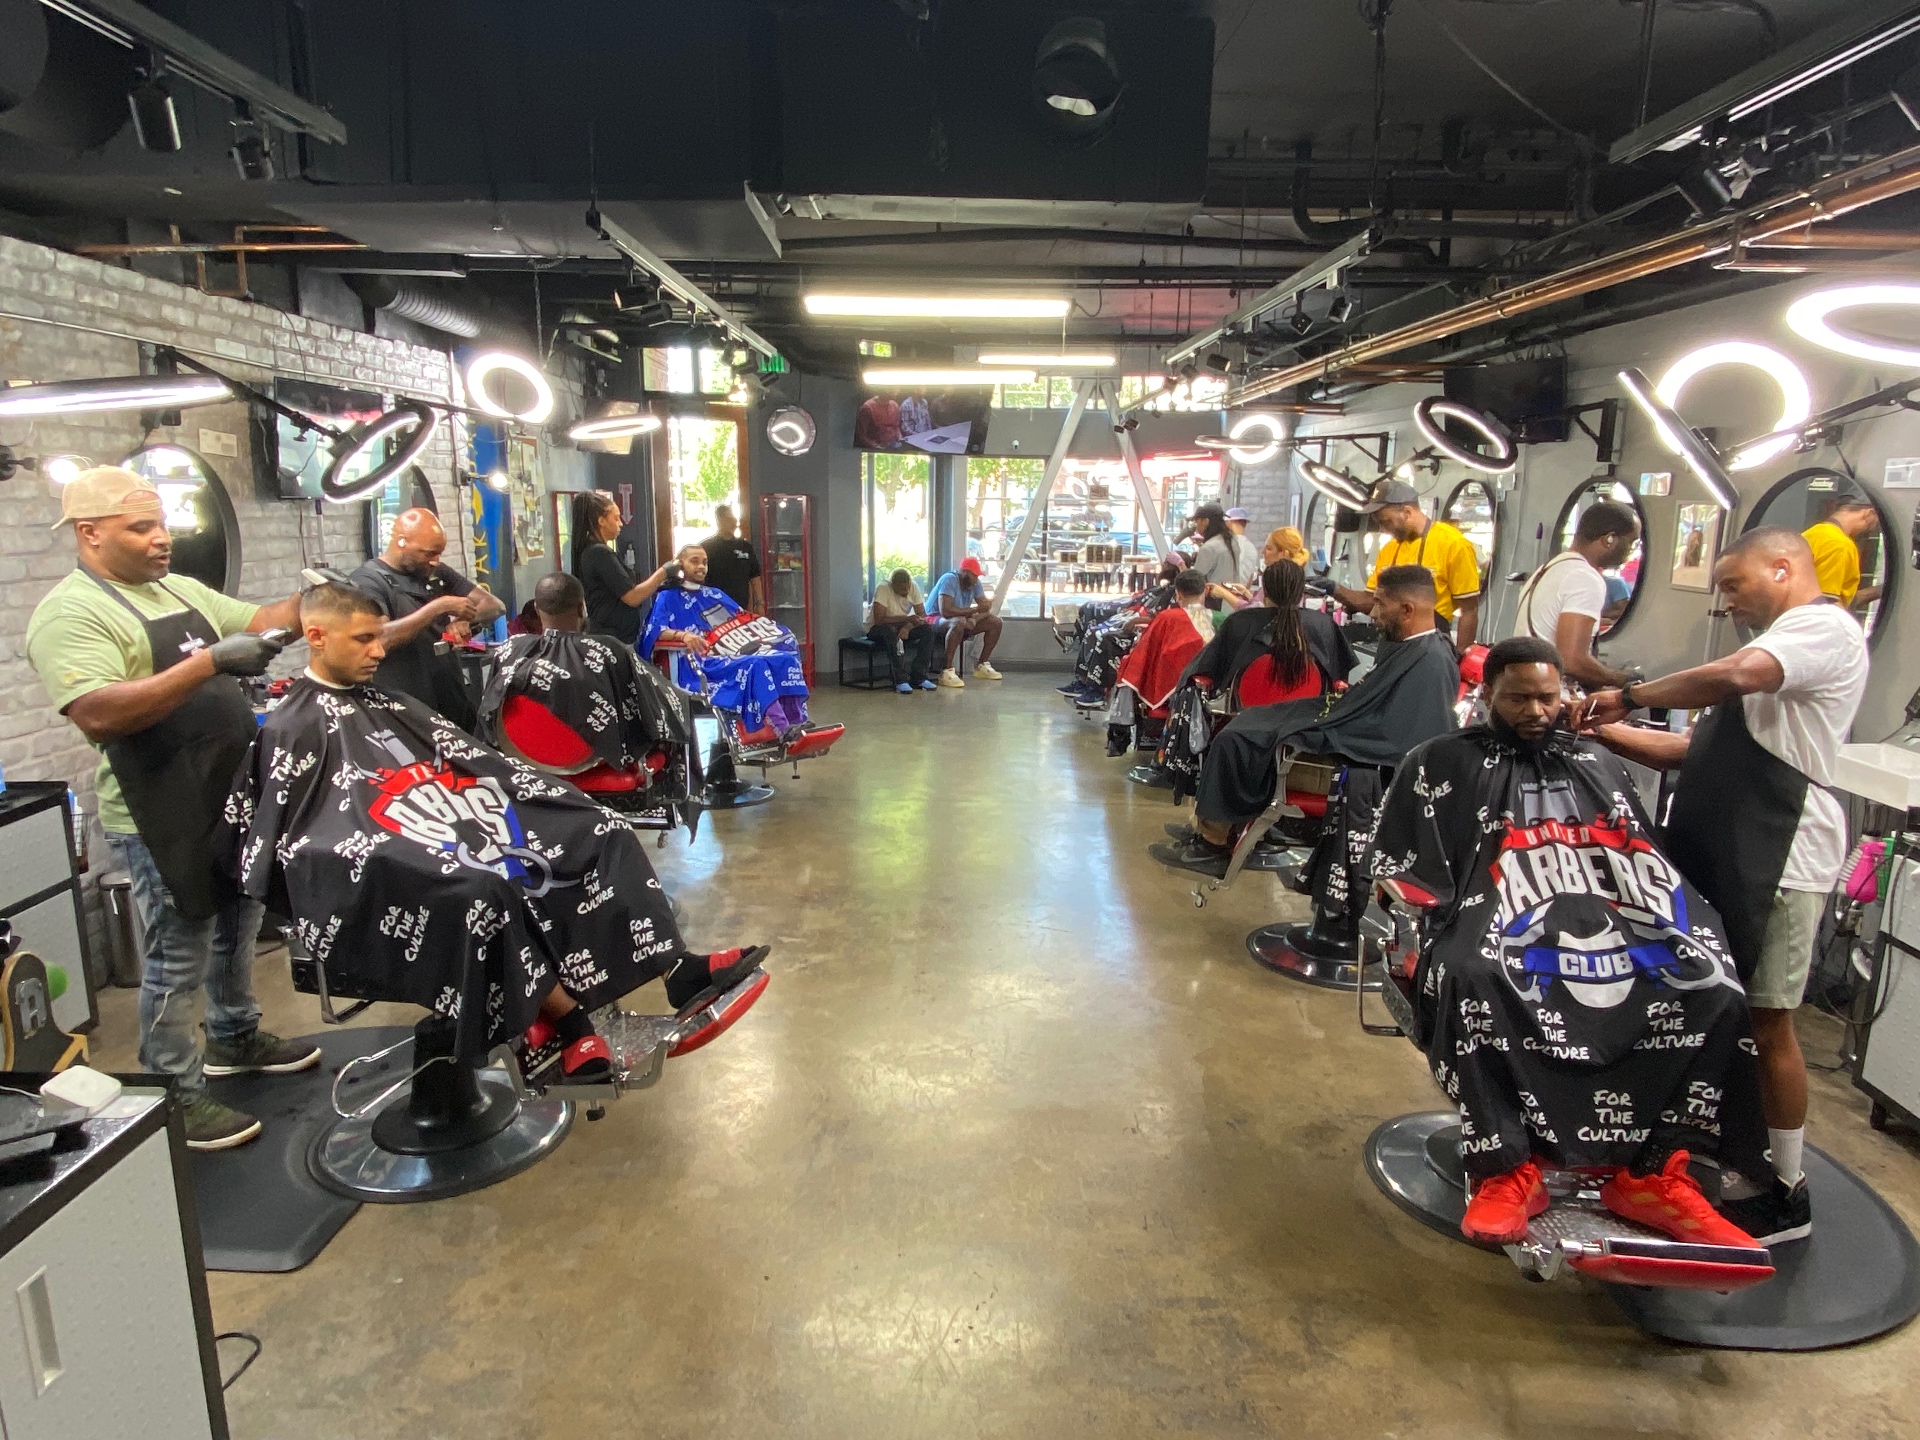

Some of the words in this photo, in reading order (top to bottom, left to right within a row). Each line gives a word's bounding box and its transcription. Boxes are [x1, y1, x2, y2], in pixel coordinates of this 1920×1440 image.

[714, 616, 784, 656] ARBERS
[586, 649, 605, 665] THE
[533, 667, 554, 683] THE
[586, 715, 605, 732] FOR
[592, 707, 611, 725] THE
[516, 786, 569, 801] CULRE
[594, 820, 634, 836] CULTU
[1348, 831, 1367, 841] FOR
[333, 830, 364, 856] FOR
[342, 836, 369, 860] THE
[351, 832, 391, 883] CULTURE
[380, 906, 401, 935] FOR
[394, 911, 415, 940] THE
[630, 918, 653, 933] FOR
[305, 923, 320, 951] THE
[317, 914, 342, 962] LTURE
[404, 906, 430, 962] CULTURE
[633, 931, 655, 946] THE
[565, 949, 592, 967] FOR
[1558, 951, 1634, 977] CLUB
[571, 961, 596, 979] THE
[575, 969, 609, 992] LTURE
[435, 986, 455, 1013] FOR
[1460, 998, 1491, 1016] FOR
[1537, 1008, 1564, 1026] FOR
[1647, 1001, 1684, 1018] FOR
[1464, 1016, 1493, 1033] THE
[1541, 1025, 1567, 1042] THE
[1649, 1017, 1685, 1032] THE
[1633, 1033, 1707, 1050] CULTURE
[1593, 1090, 1633, 1106] FOR
[1595, 1108, 1634, 1125] THE
[1687, 1097, 1719, 1118] THE
[1462, 1133, 1502, 1155] TURE
